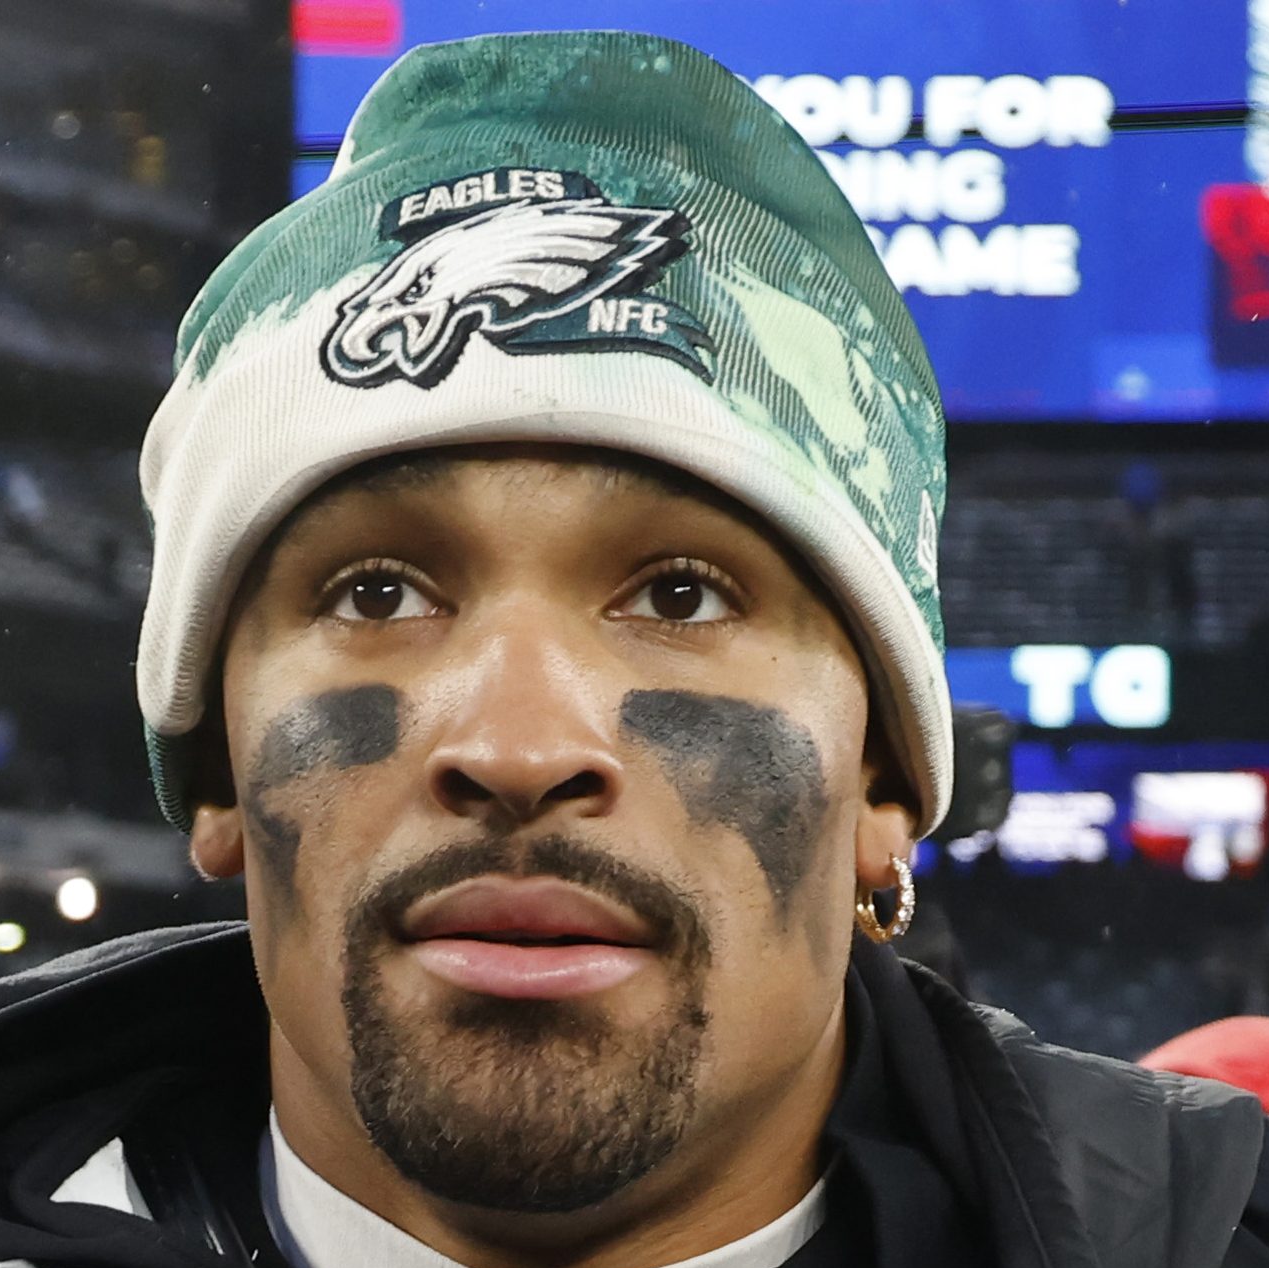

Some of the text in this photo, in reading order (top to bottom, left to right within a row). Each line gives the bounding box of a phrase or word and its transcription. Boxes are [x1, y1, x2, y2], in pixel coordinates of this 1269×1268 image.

[923, 74, 1116, 149] FOR
[398, 170, 564, 227] EAGLES
[818, 149, 1006, 223] ING
[863, 224, 1082, 297] AME
[587, 297, 669, 335] NFC
